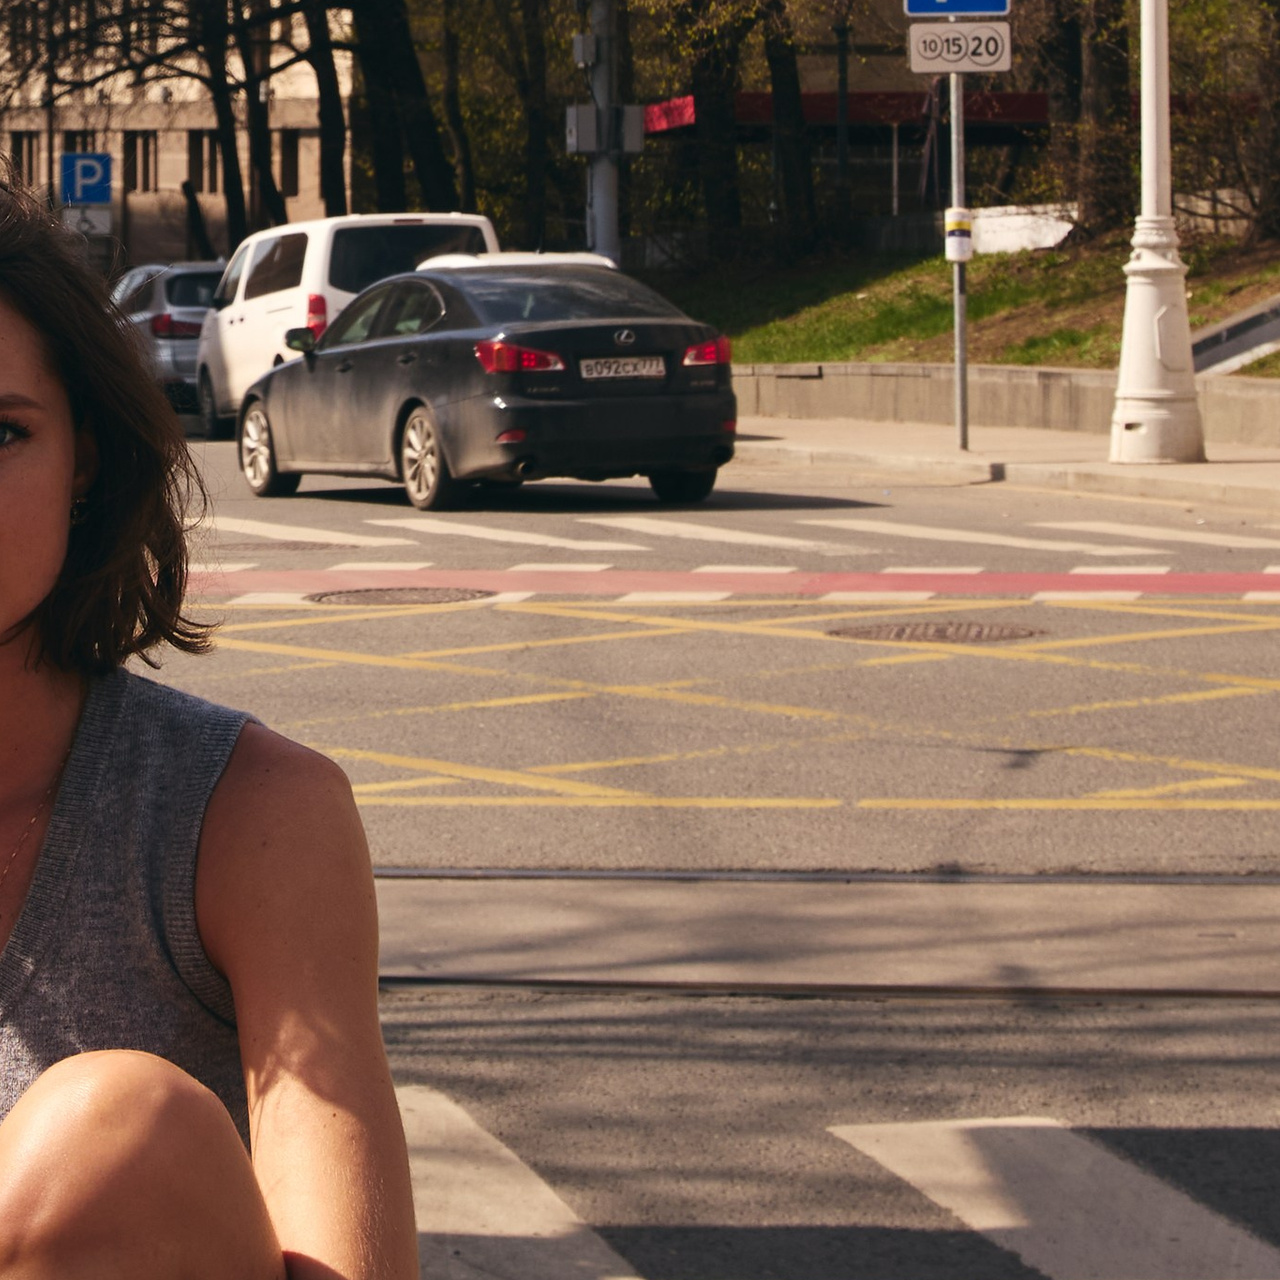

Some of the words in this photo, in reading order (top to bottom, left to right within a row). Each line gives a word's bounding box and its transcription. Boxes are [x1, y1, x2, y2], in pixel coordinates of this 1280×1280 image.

[922, 39, 938, 52] 10
[944, 37, 963, 55] 15
[970, 36, 999, 56] 20
[74, 158, 103, 199] P
